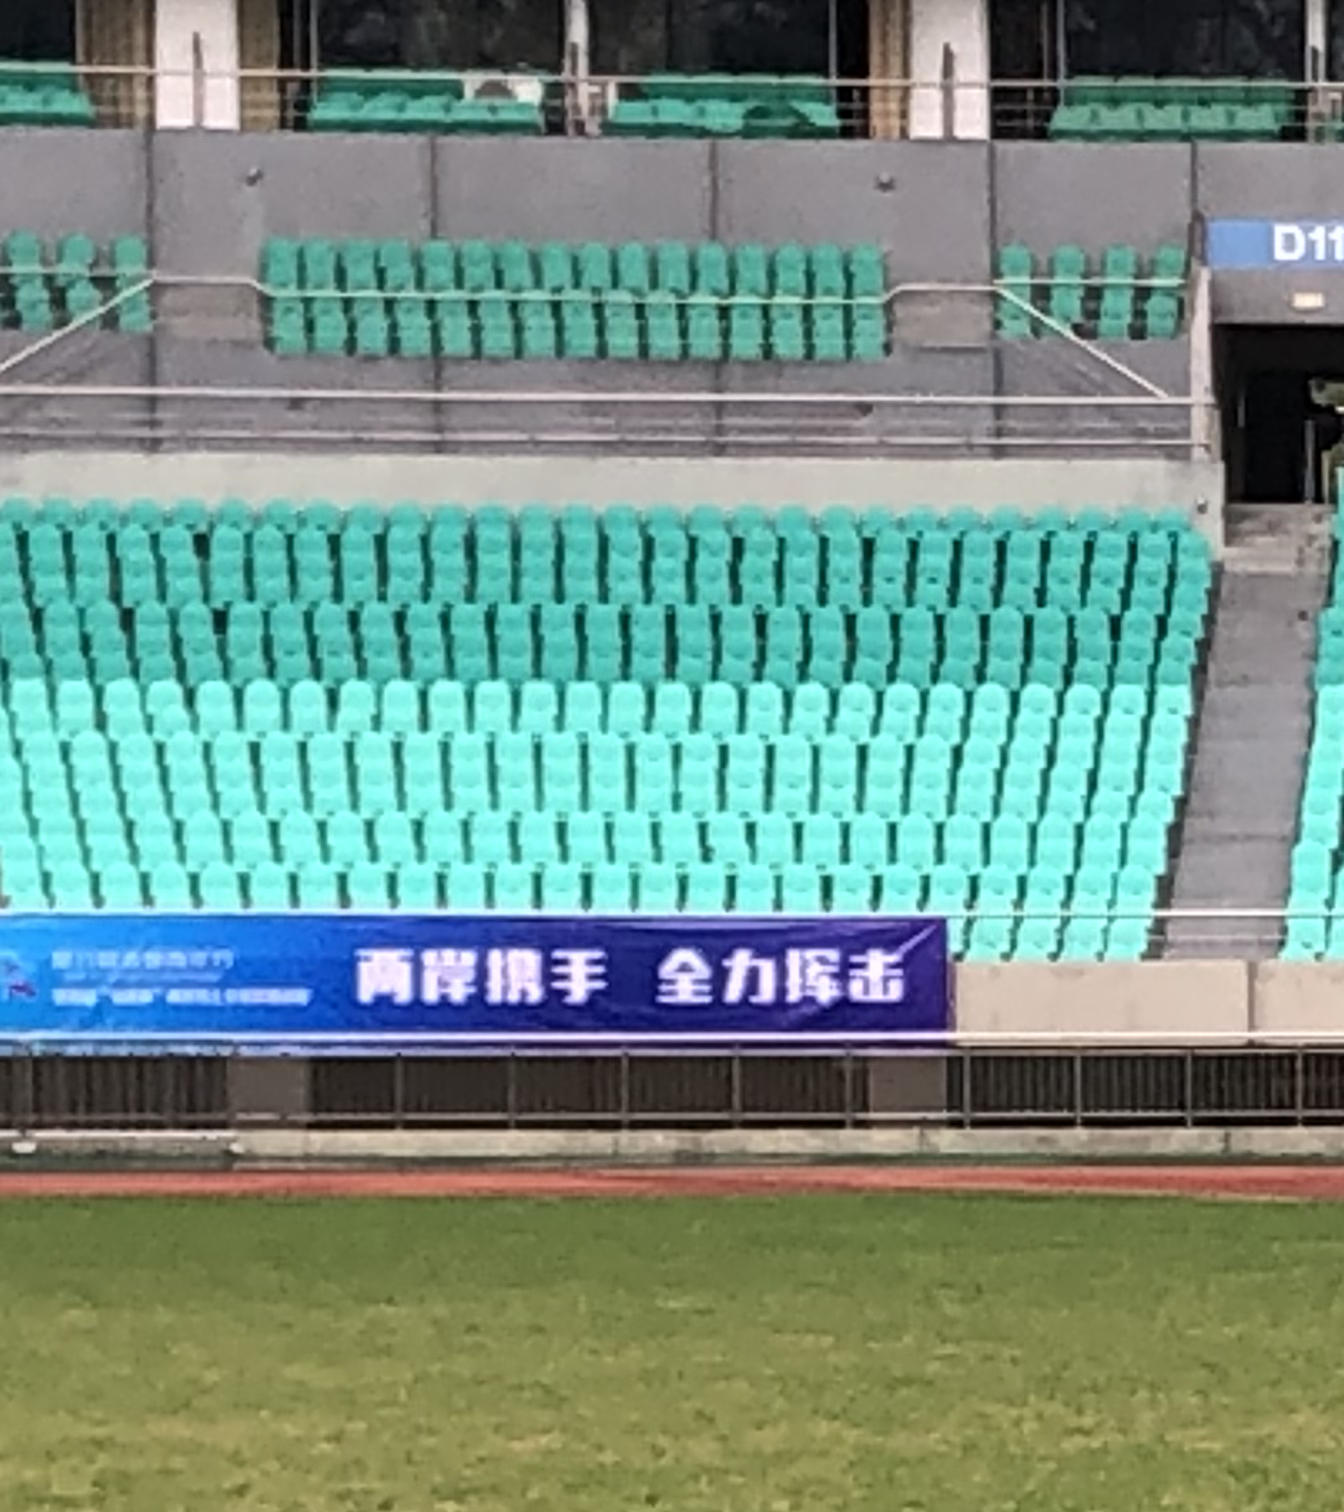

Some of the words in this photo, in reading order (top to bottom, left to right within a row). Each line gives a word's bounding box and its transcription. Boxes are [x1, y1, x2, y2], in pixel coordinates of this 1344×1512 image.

[354, 948, 608, 1004] 两岸携手
[656, 947, 904, 1004] 全力挥击
